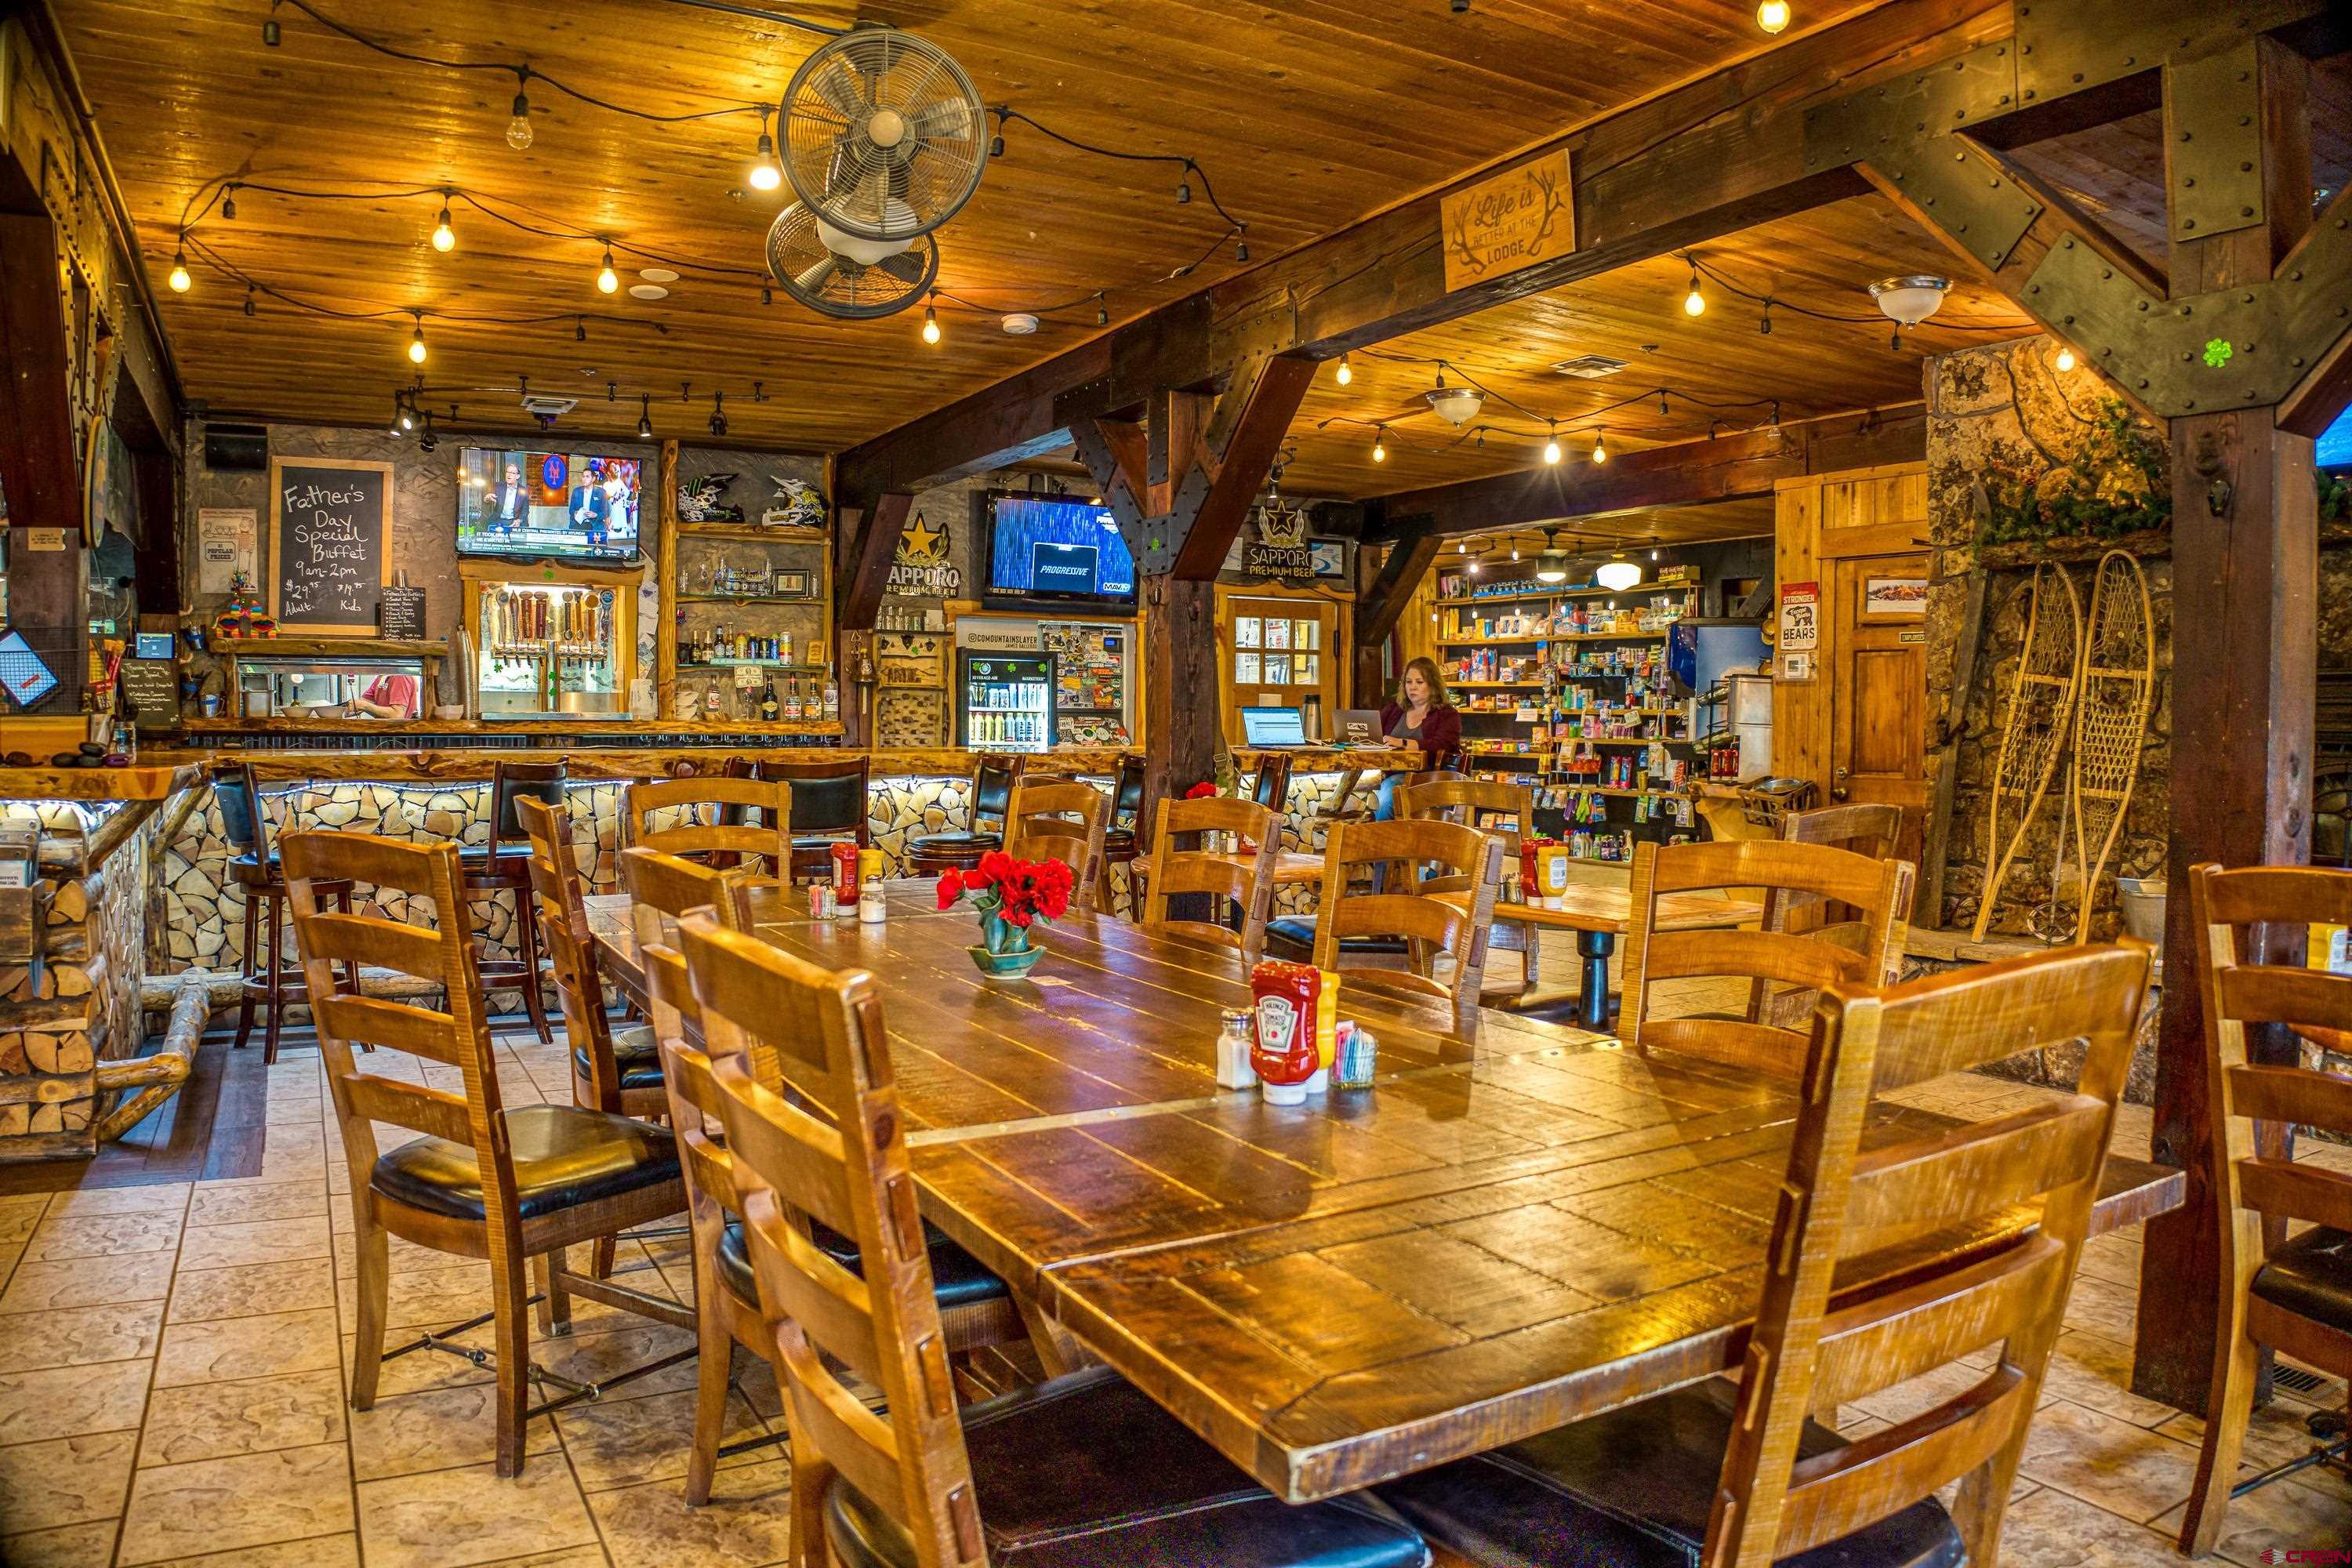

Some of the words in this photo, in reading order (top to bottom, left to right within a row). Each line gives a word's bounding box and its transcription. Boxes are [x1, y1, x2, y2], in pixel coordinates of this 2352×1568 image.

[1475, 193, 1516, 227] Life
[1519, 187, 1535, 209] is
[1473, 227, 1504, 246] BETTER
[1507, 224, 1518, 237] AT
[1520, 215, 1537, 230] THE
[1487, 239, 1525, 264] LODGE
[284, 484, 365, 513] Father's
[315, 510, 352, 533] Day
[295, 525, 368, 548] Special
[314, 543, 367, 563] Buffet
[1250, 548, 1315, 566] SAPPORO
[887, 565, 960, 588] APPORO
[1040, 565, 1090, 576] PROGRESSIVE
[1250, 565, 1292, 577] PREMIUM
[1294, 567, 1315, 577] BEER
[886, 584, 930, 594] REMIUM
[932, 586, 956, 596] BEER
[1783, 594, 1815, 604] STRONGER
[285, 601, 312, 616] Adult
[339, 599, 361, 612] Kids
[1783, 628, 1815, 640] BEARS
